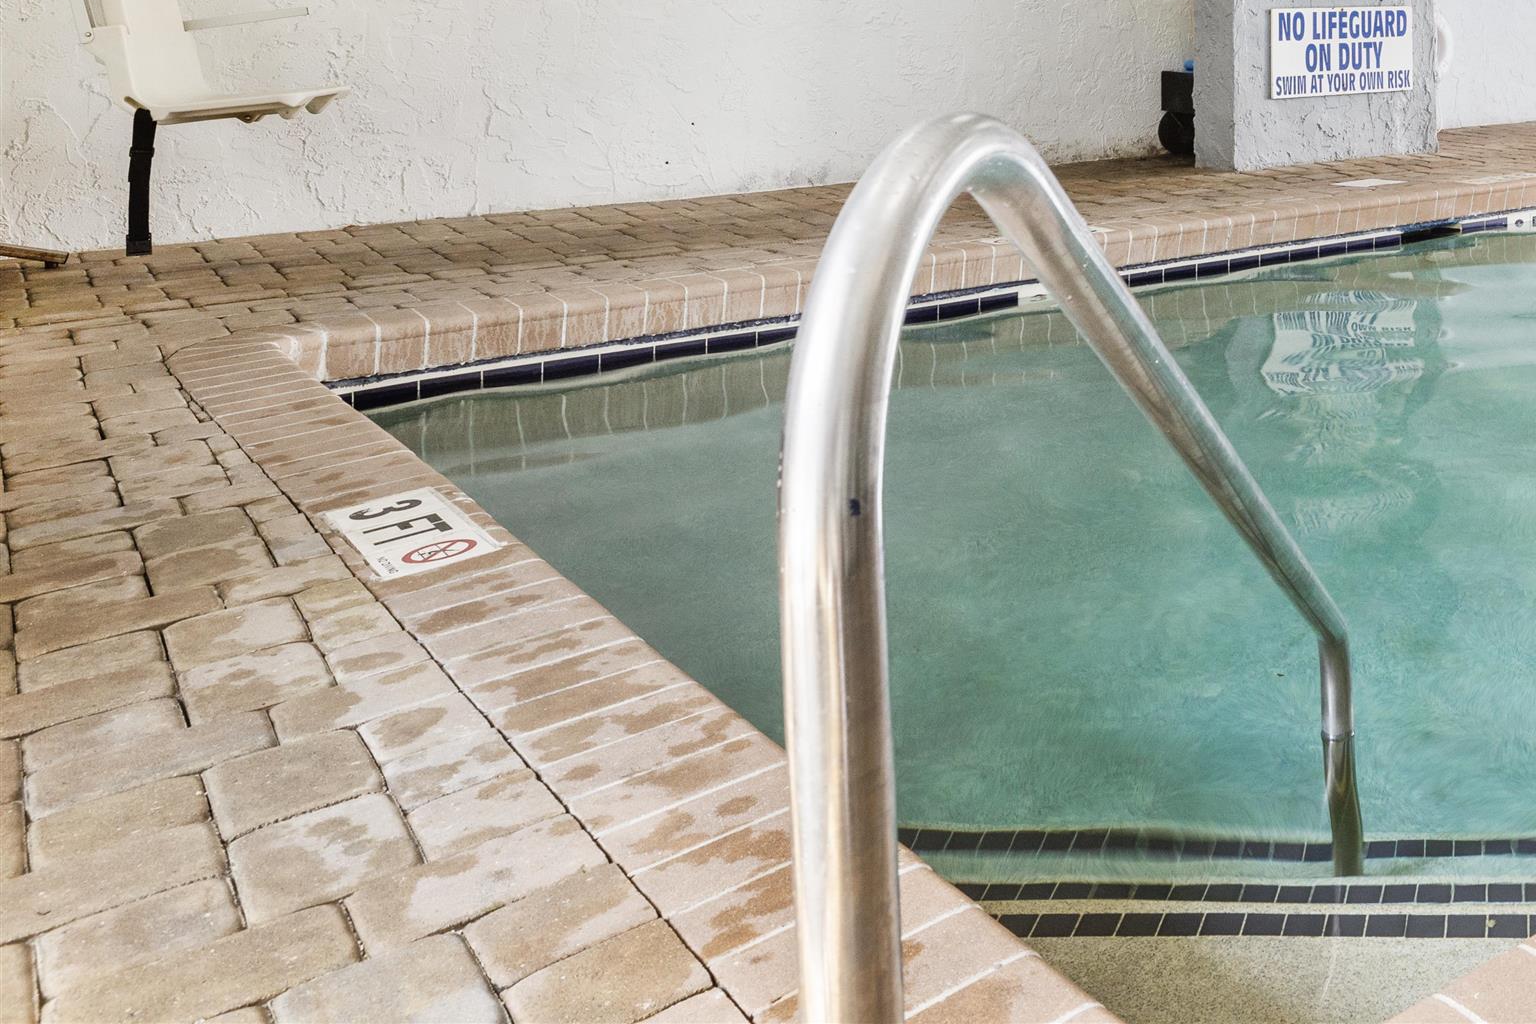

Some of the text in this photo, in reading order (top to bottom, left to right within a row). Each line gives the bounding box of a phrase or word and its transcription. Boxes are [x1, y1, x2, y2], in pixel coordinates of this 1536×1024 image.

[1278, 10, 1407, 41] NO LIFEGUARD
[1305, 41, 1383, 72] ON DUTY
[1276, 70, 1410, 96] SWIM AT YOUR OWN RISK
[349, 499, 453, 546] 3 FT
